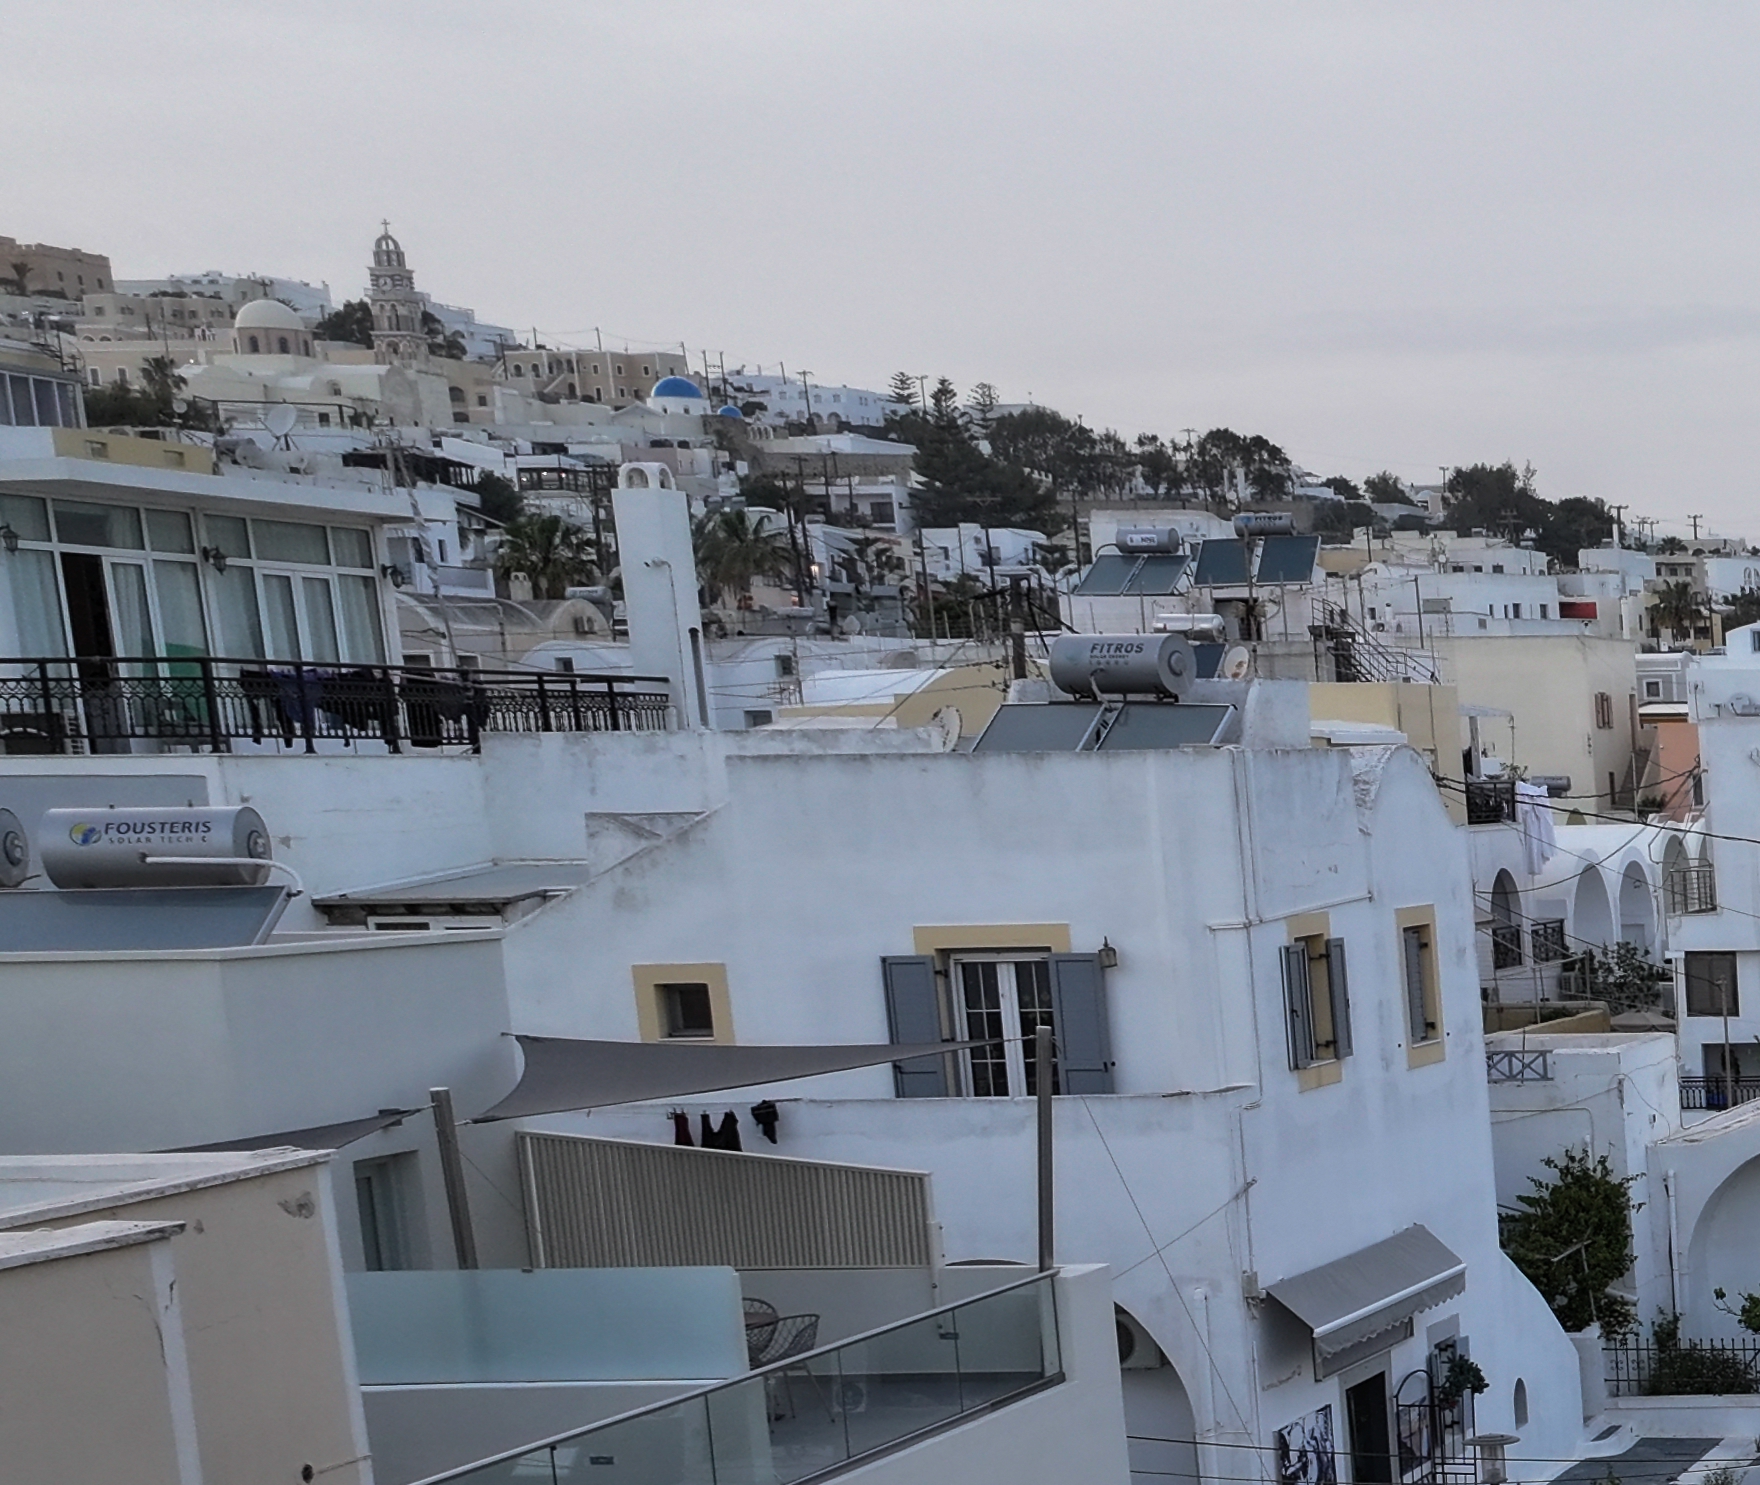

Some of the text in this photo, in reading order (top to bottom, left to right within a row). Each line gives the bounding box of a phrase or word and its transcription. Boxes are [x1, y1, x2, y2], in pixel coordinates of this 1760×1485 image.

[1090, 642, 1145, 654] FITROS
[104, 820, 212, 835] FOUSTERIS
[108, 836, 152, 844] SOLAR
[160, 835, 194, 844] TECH
